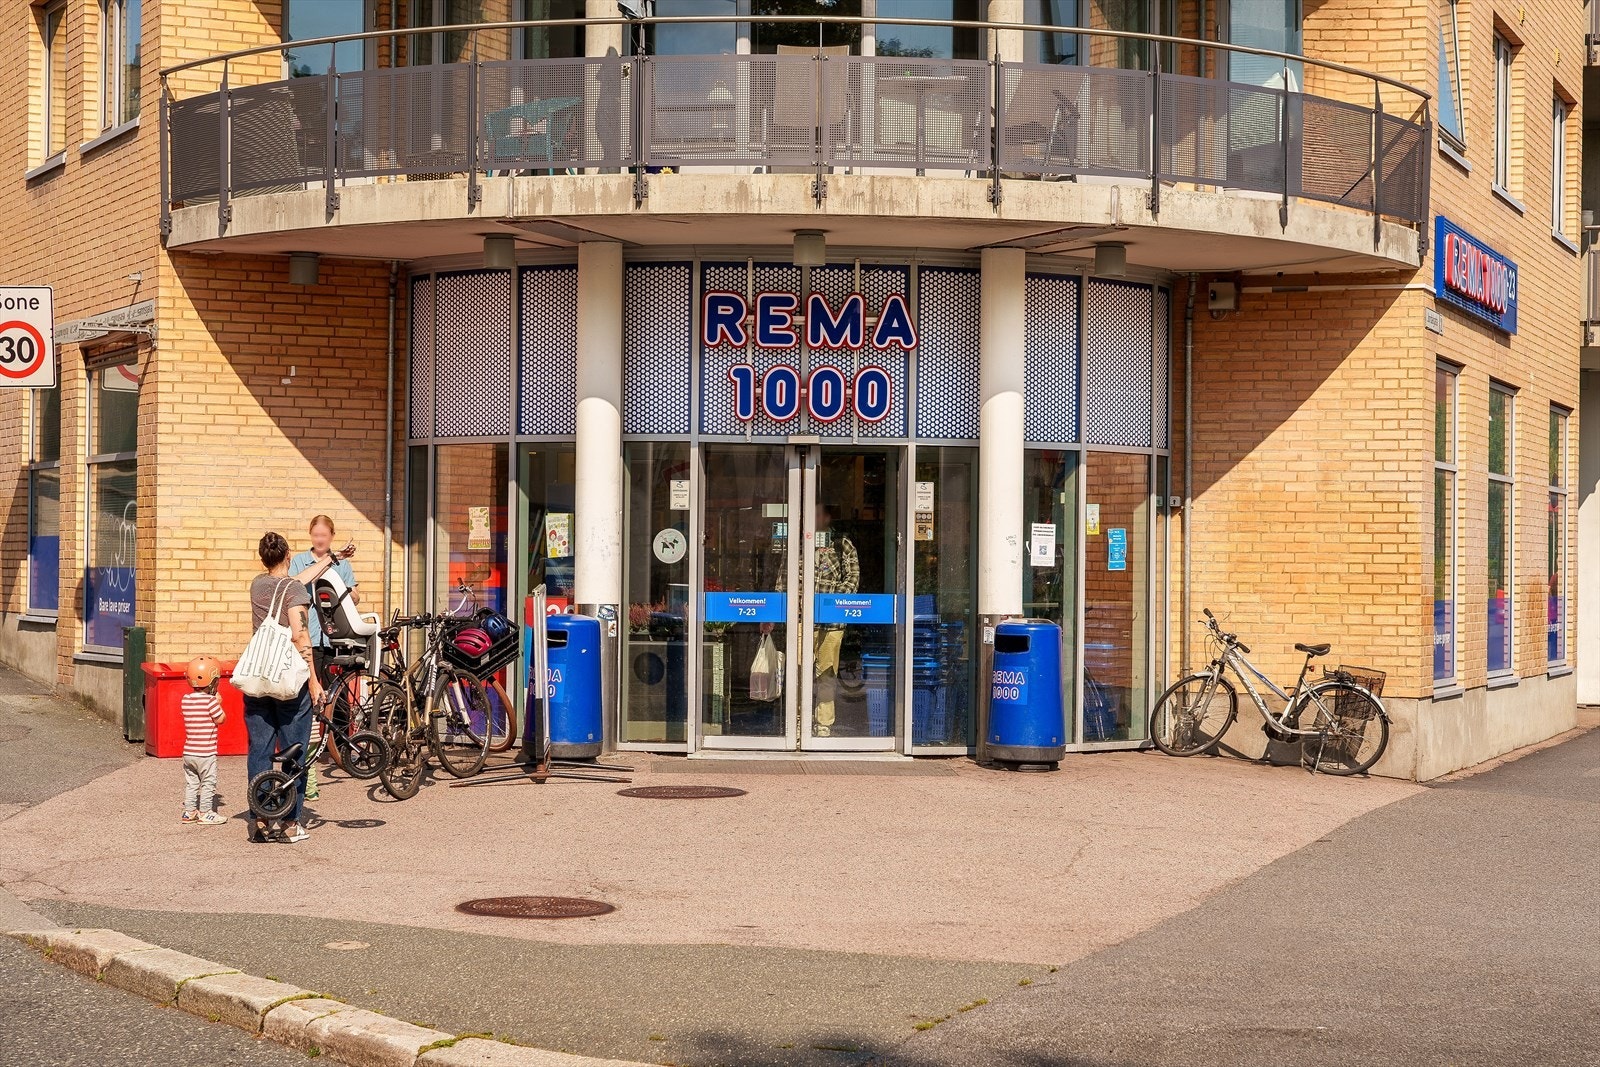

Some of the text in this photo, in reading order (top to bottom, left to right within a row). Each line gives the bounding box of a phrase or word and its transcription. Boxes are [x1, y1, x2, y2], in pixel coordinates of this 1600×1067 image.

[1445, 233, 1484, 301] REMA
[0, 293, 40, 311] one
[703, 290, 918, 351] REMA
[0, 336, 35, 364] 30
[727, 363, 893, 423] 1000
[98, 597, 109, 612] Bare
[117, 598, 131, 615] priser
[738, 608, 756, 616] 7-23
[844, 609, 862, 617] 7-23
